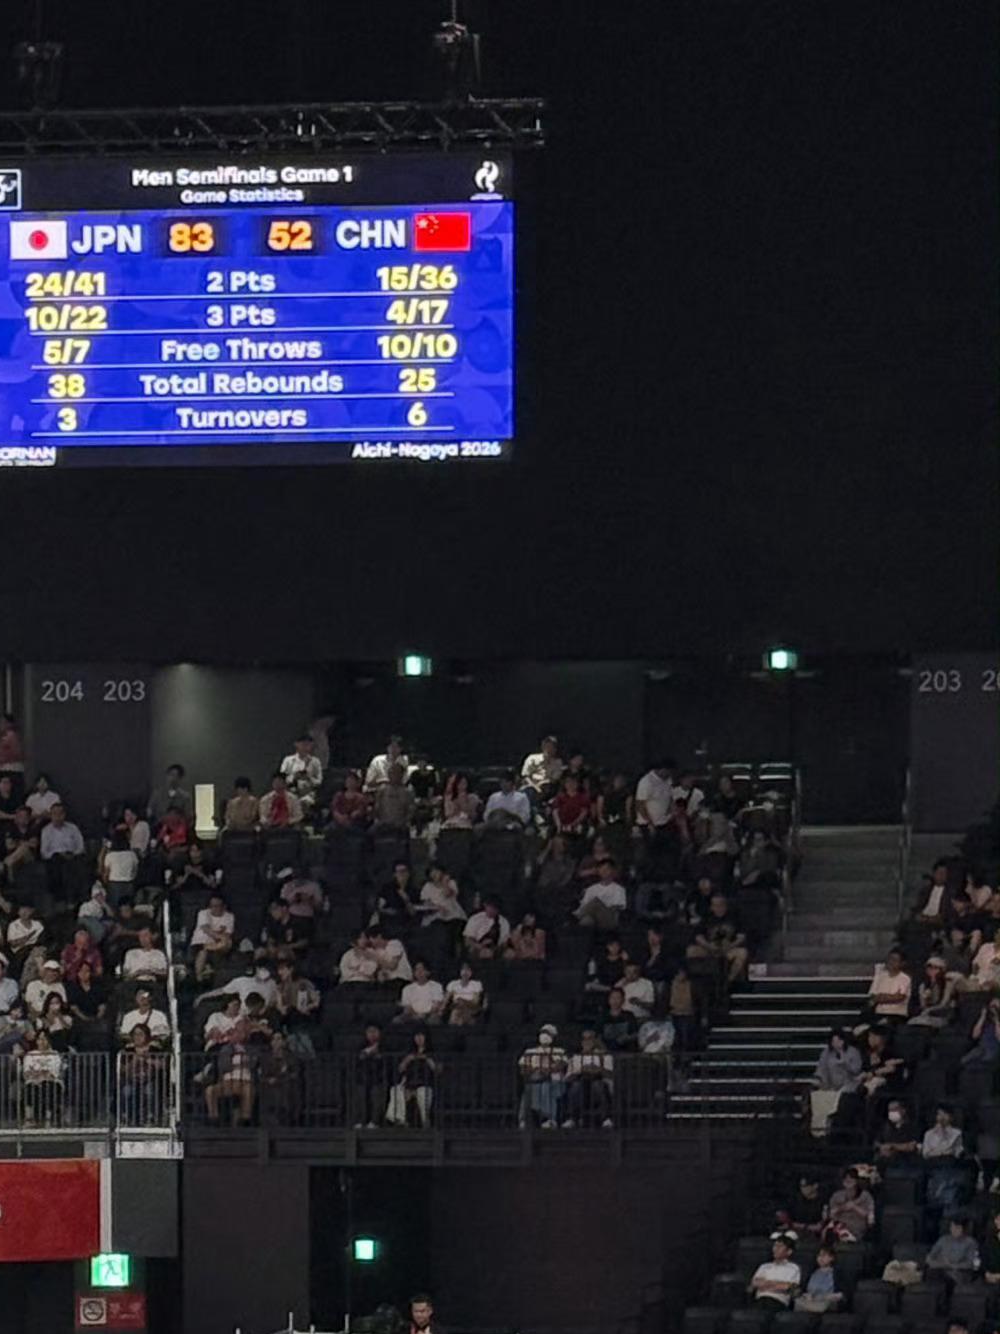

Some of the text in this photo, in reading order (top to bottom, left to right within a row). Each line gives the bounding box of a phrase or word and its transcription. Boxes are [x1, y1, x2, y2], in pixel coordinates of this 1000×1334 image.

[132, 166, 353, 186] Men Semifinals Game 1
[181, 187, 304, 204] Game Statistics
[72, 225, 142, 253] JPN
[169, 223, 214, 252] 83
[267, 221, 313, 250] 52
[336, 220, 405, 248] CHN
[25, 271, 106, 296] 24/41
[207, 271, 275, 293] 2 Pts
[376, 264, 457, 290] 15/36
[25, 305, 107, 330] 10/22
[207, 304, 275, 326] 3 Pts
[386, 299, 448, 324] 4/17
[43, 338, 90, 364] 5/7
[161, 338, 322, 361] Free Throws
[377, 333, 457, 358] 10/10
[48, 374, 85, 397] 38
[139, 370, 343, 395] Total Rebounds
[399, 368, 436, 392] 25
[57, 408, 77, 431] 3
[177, 407, 307, 428] Turnovers
[407, 402, 427, 426] 6
[352, 441, 500, 460] Aichi-Nagoya 2026
[41, 680, 145, 701] 204 203
[919, 670, 1000, 692] 203 2
